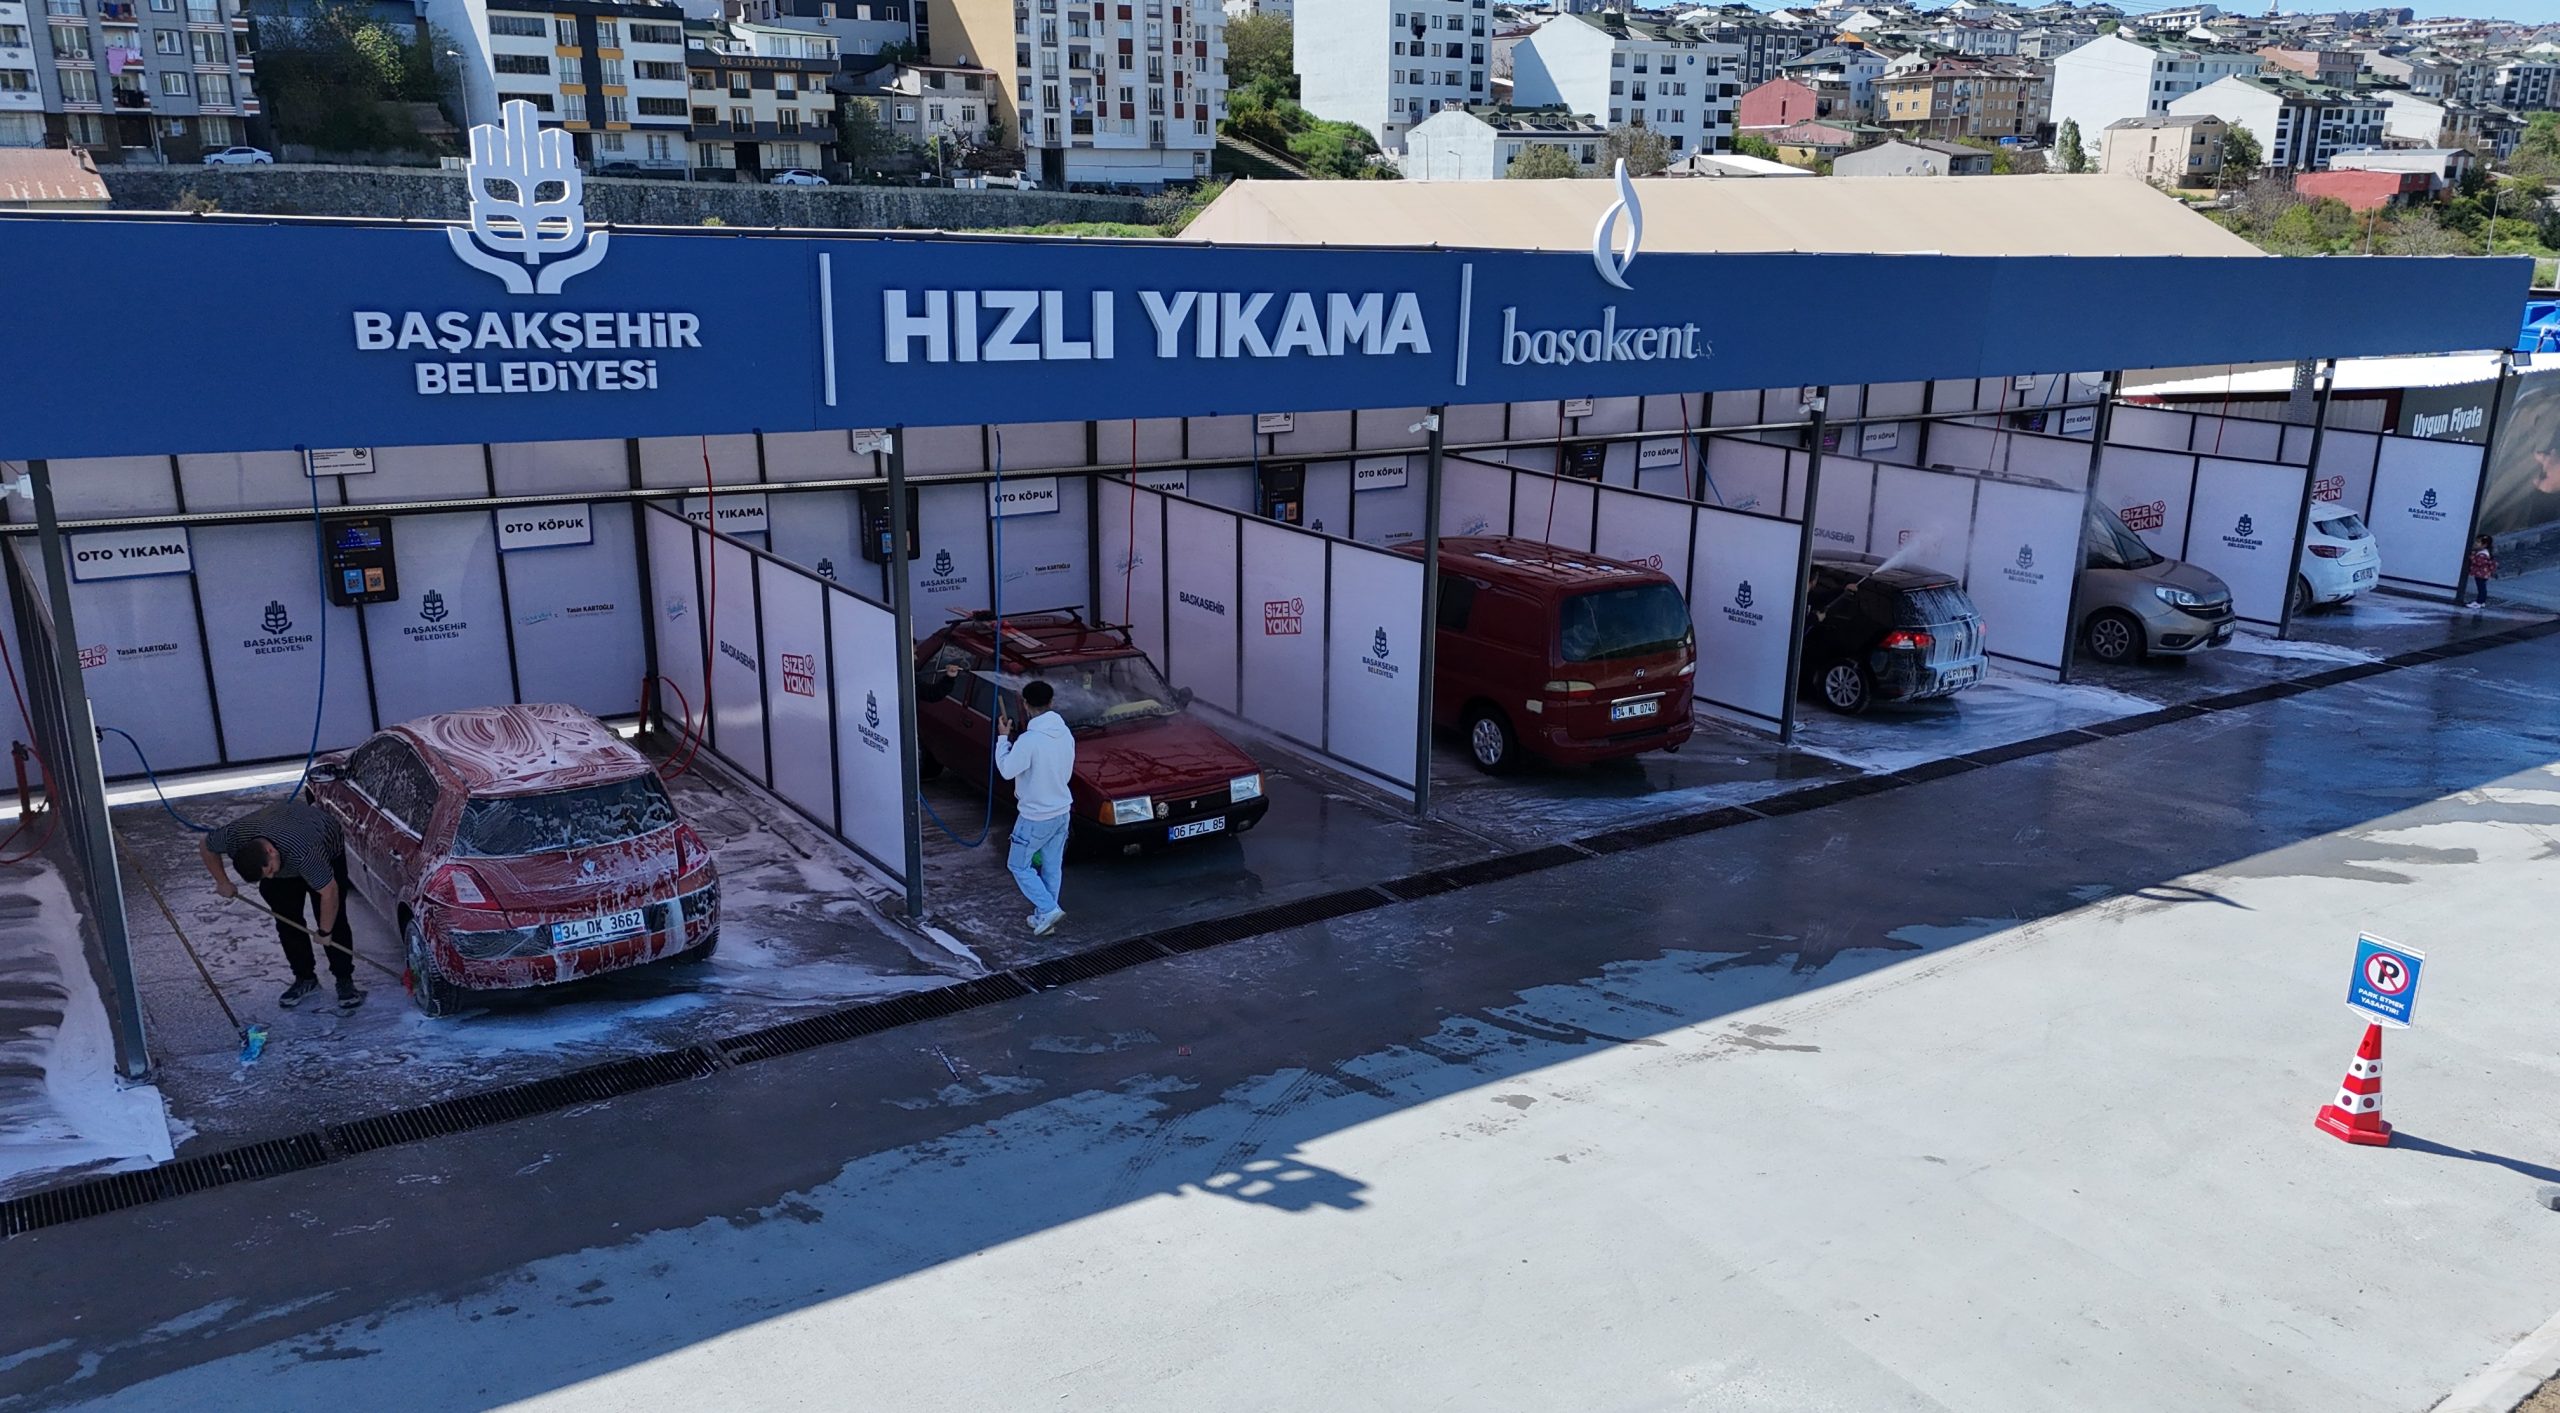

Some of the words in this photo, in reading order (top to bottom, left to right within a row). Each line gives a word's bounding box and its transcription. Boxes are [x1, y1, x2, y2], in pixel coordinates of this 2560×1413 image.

[353, 310, 702, 354] BAŞAKŞEHİR
[884, 289, 1114, 362] HIZLI
[1138, 291, 1432, 358] YIKAMA
[415, 359, 659, 395] BELEDİYESİ
[2412, 413, 2449, 438] Uygun
[2449, 405, 2483, 433] Fiyata
[1643, 450, 1657, 458] OTO
[1358, 470, 1375, 479] OTO
[716, 507, 764, 519] YIKAMA
[505, 522, 533, 534] OTO
[538, 518, 584, 531] KÖPUK
[77, 549, 113, 562] OTO
[118, 544, 185, 559] YIKAMA
[116, 648, 137, 656] Yasin
[138, 642, 179, 654] KARTOĞLU
[1617, 708, 1624, 717] 34
[1174, 827, 1186, 838] 06
[1188, 821, 1209, 835] FZL
[1212, 817, 1224, 830] 85
[562, 925, 579, 939] 34
[587, 919, 603, 934] DK
[610, 911, 640, 930] 3662
[2358, 987, 2378, 999] PARK
[2379, 995, 2405, 1010] ETMEK
